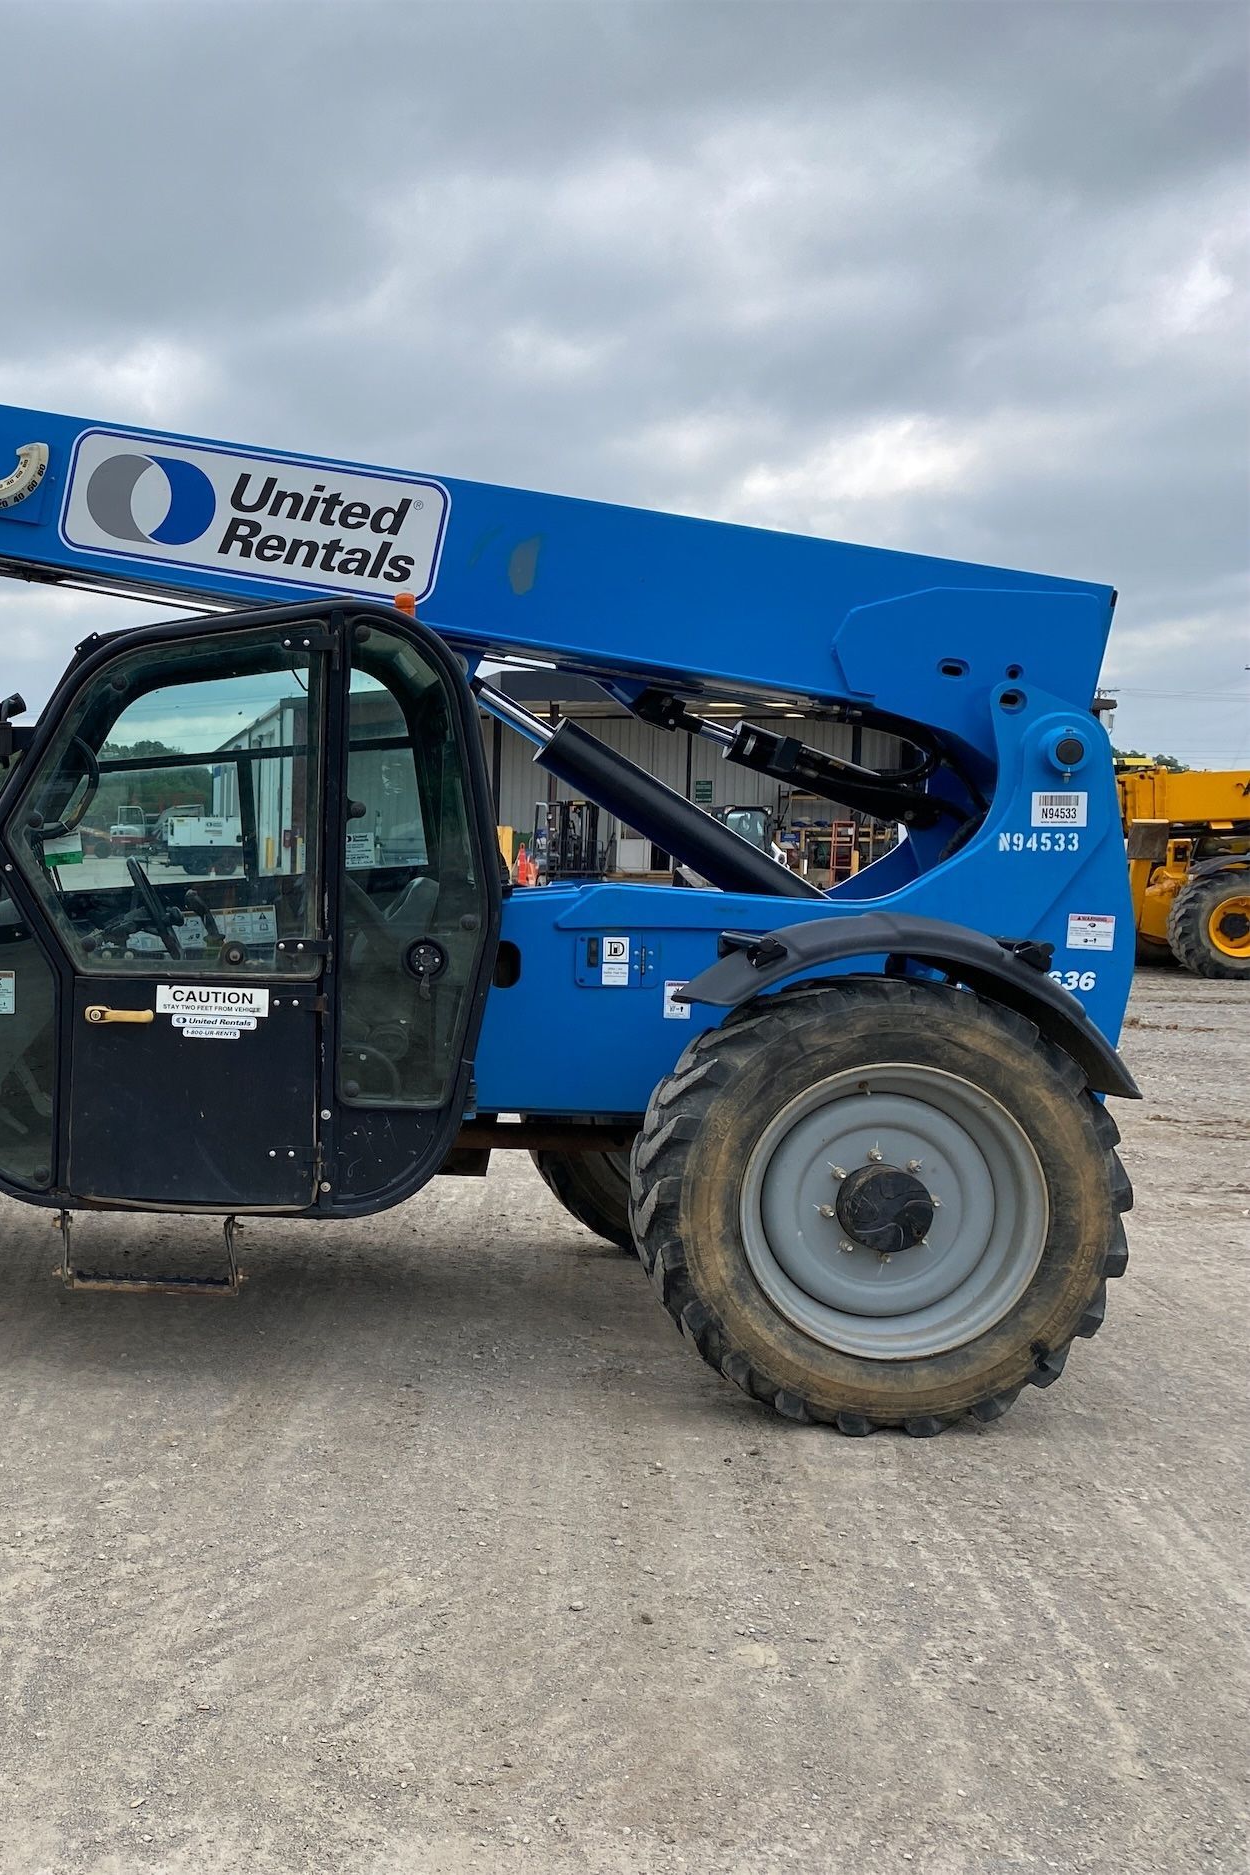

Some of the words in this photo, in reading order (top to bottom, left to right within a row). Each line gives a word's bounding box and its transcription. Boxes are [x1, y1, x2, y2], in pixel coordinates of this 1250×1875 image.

[13, 492, 25, 503] 40
[27, 480, 38, 492] 60
[230, 473, 412, 536] United
[217, 517, 415, 583] Rentals
[1041, 808, 1077, 819] N94533
[998, 832, 1079, 852] N94533
[607, 941, 625, 957] D
[172, 990, 254, 1004] CAUTION
[188, 1017, 217, 1026] United
[219, 1018, 252, 1027] Rentals
